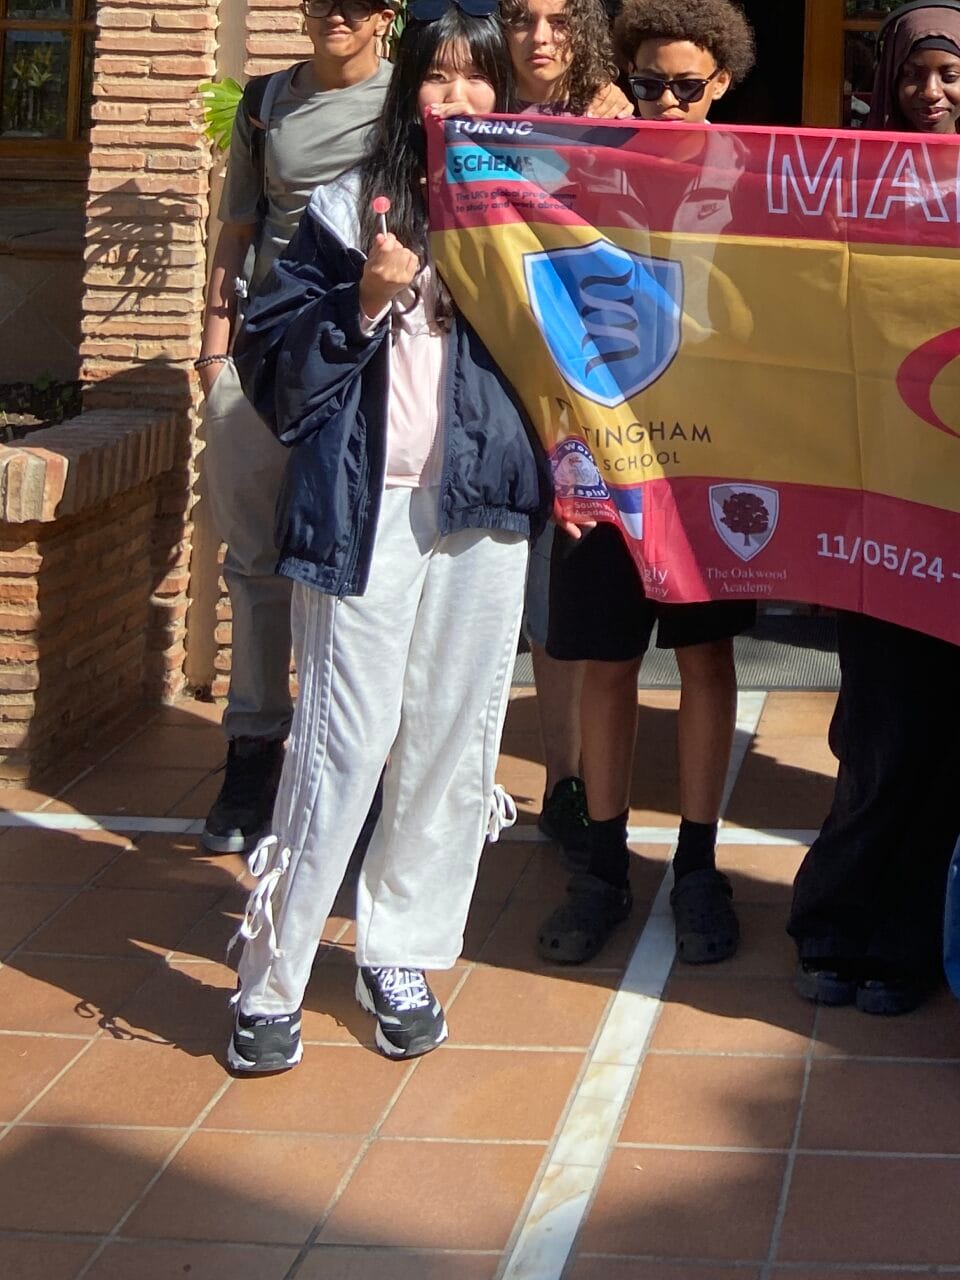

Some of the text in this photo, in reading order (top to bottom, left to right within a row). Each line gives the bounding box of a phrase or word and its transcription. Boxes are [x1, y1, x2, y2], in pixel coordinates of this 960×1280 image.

[454, 120, 534, 135] TURING
[453, 154, 533, 173] SCHEME
[603, 451, 681, 472] SCHOOL
[816, 532, 945, 583] 11/05/24
[707, 568, 787, 580] The Oakwood
[720, 583, 774, 595] Academy
